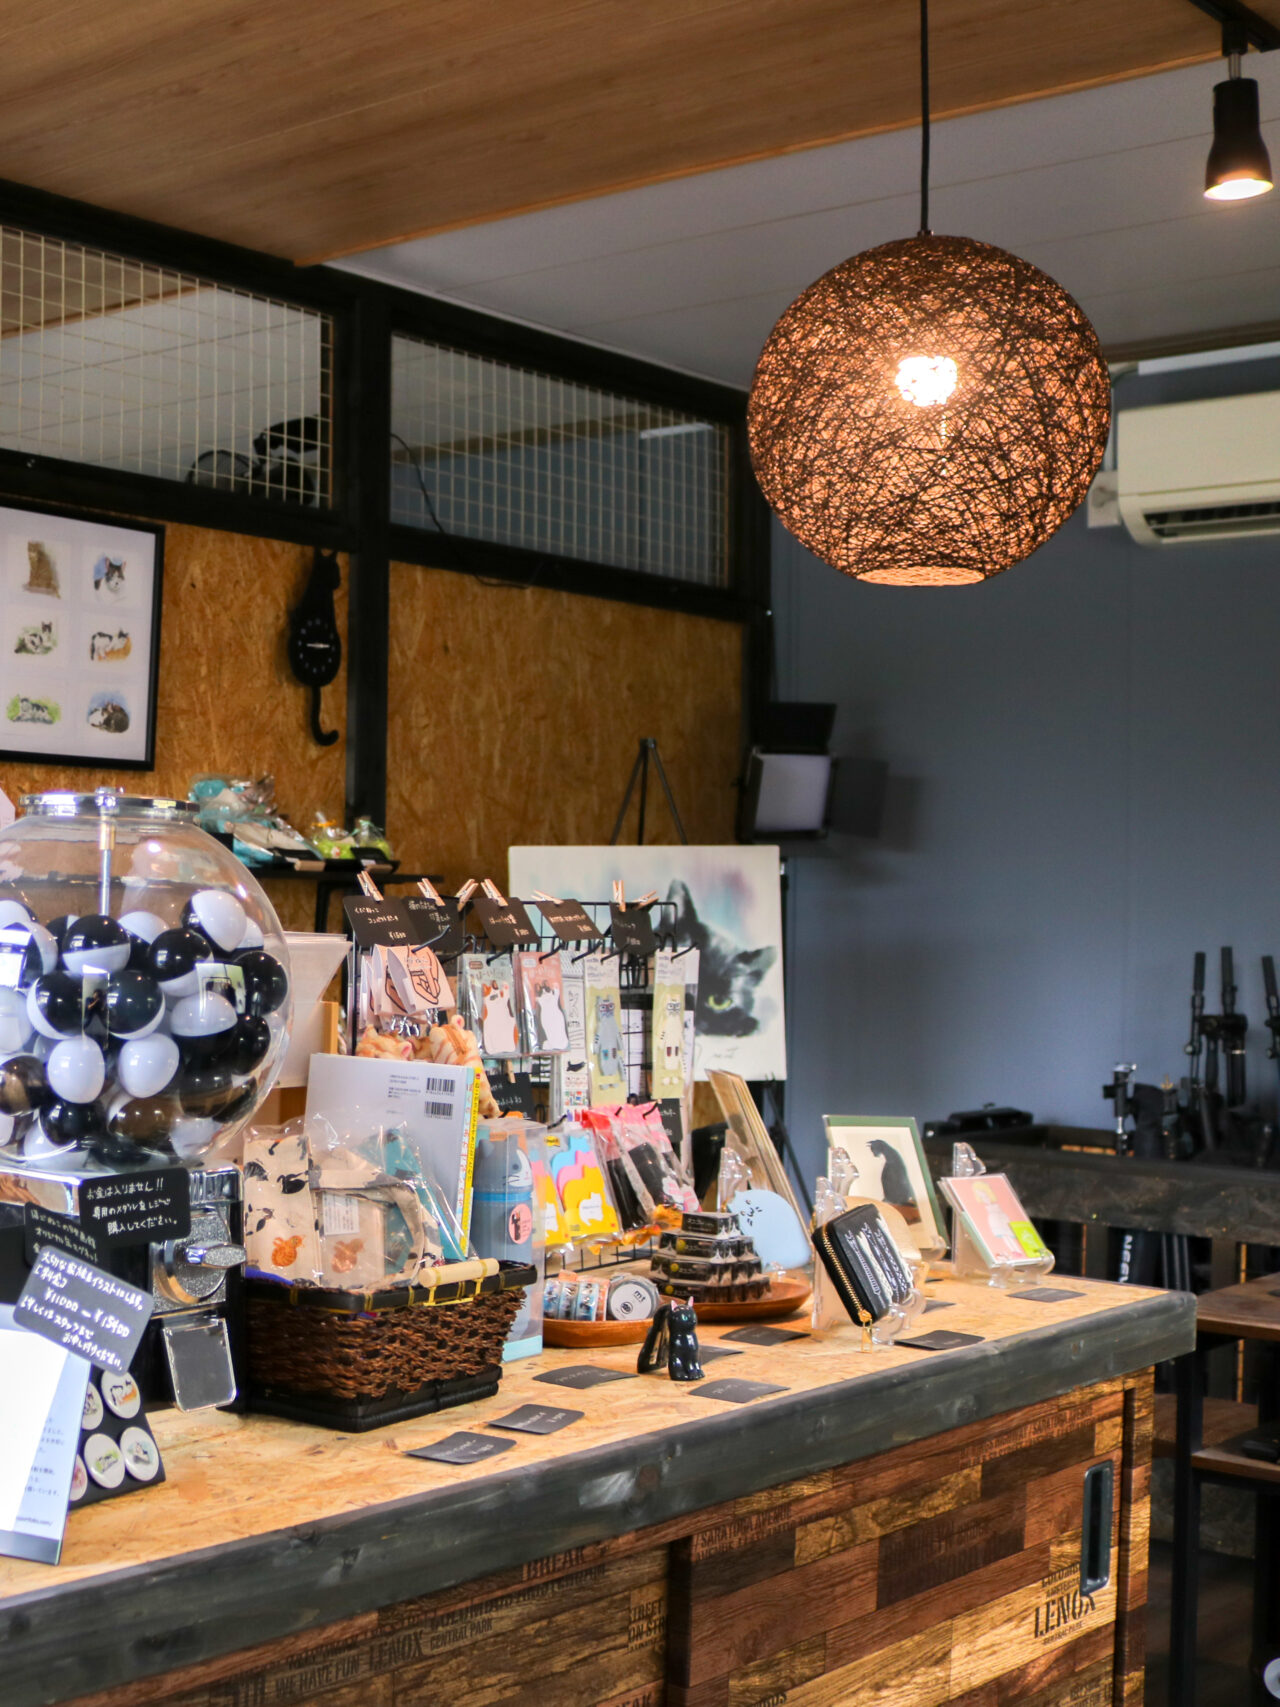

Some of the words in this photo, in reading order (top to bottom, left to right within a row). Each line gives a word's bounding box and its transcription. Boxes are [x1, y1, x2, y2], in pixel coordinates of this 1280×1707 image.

[633, 1289, 646, 1302] mt
[430, 1625, 467, 1651] CENTRAL
[470, 1616, 493, 1639] PARK
[298, 1664, 333, 1692] HAVE
[334, 1653, 361, 1681] FUN
